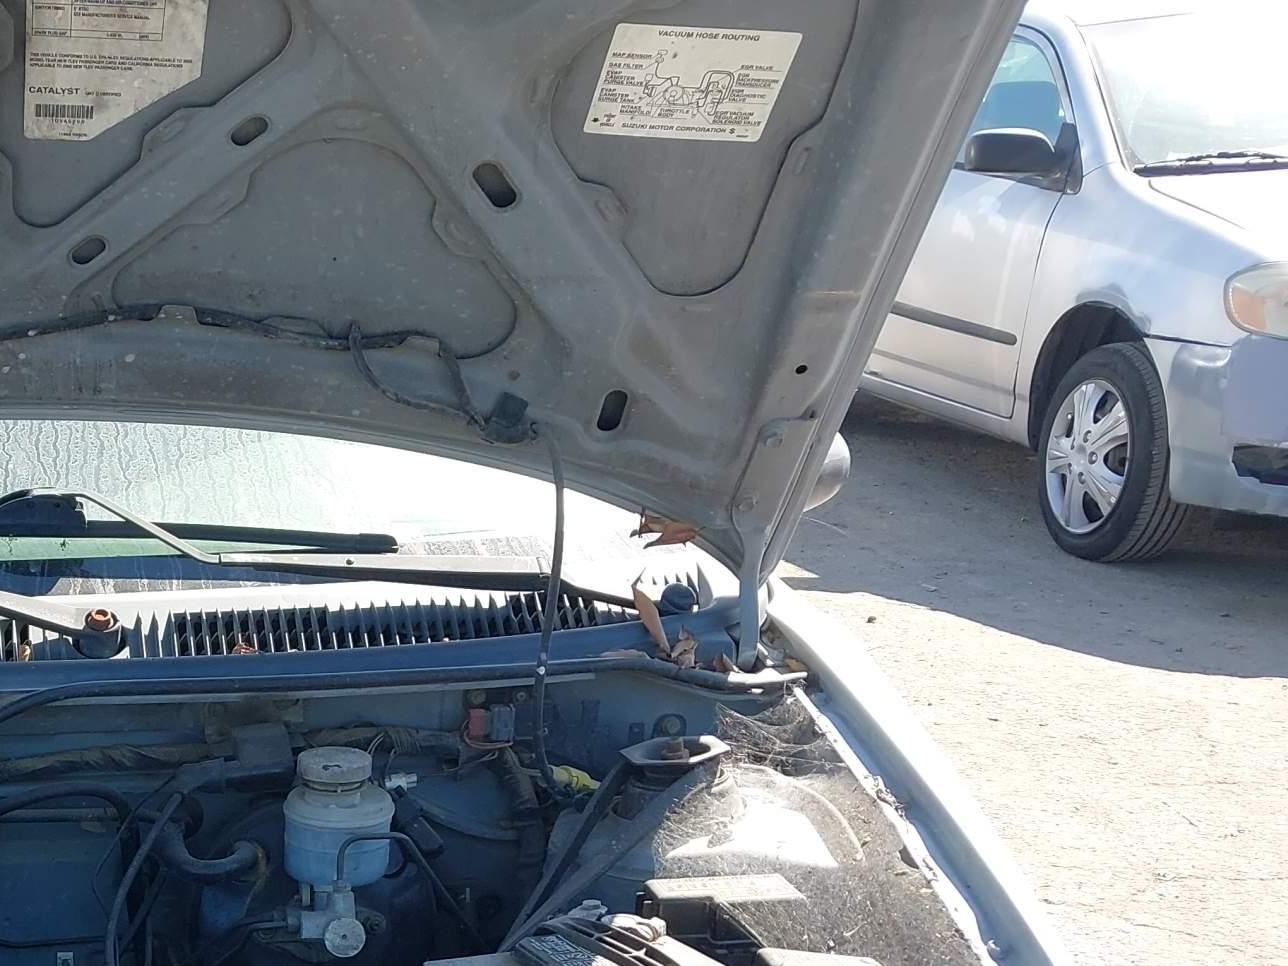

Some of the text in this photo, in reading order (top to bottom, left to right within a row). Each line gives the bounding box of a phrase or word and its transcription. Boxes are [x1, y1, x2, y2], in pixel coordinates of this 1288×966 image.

[658, 29, 760, 42] VACUUM HOSE ROUTING
[29, 86, 80, 95] CATALYST
